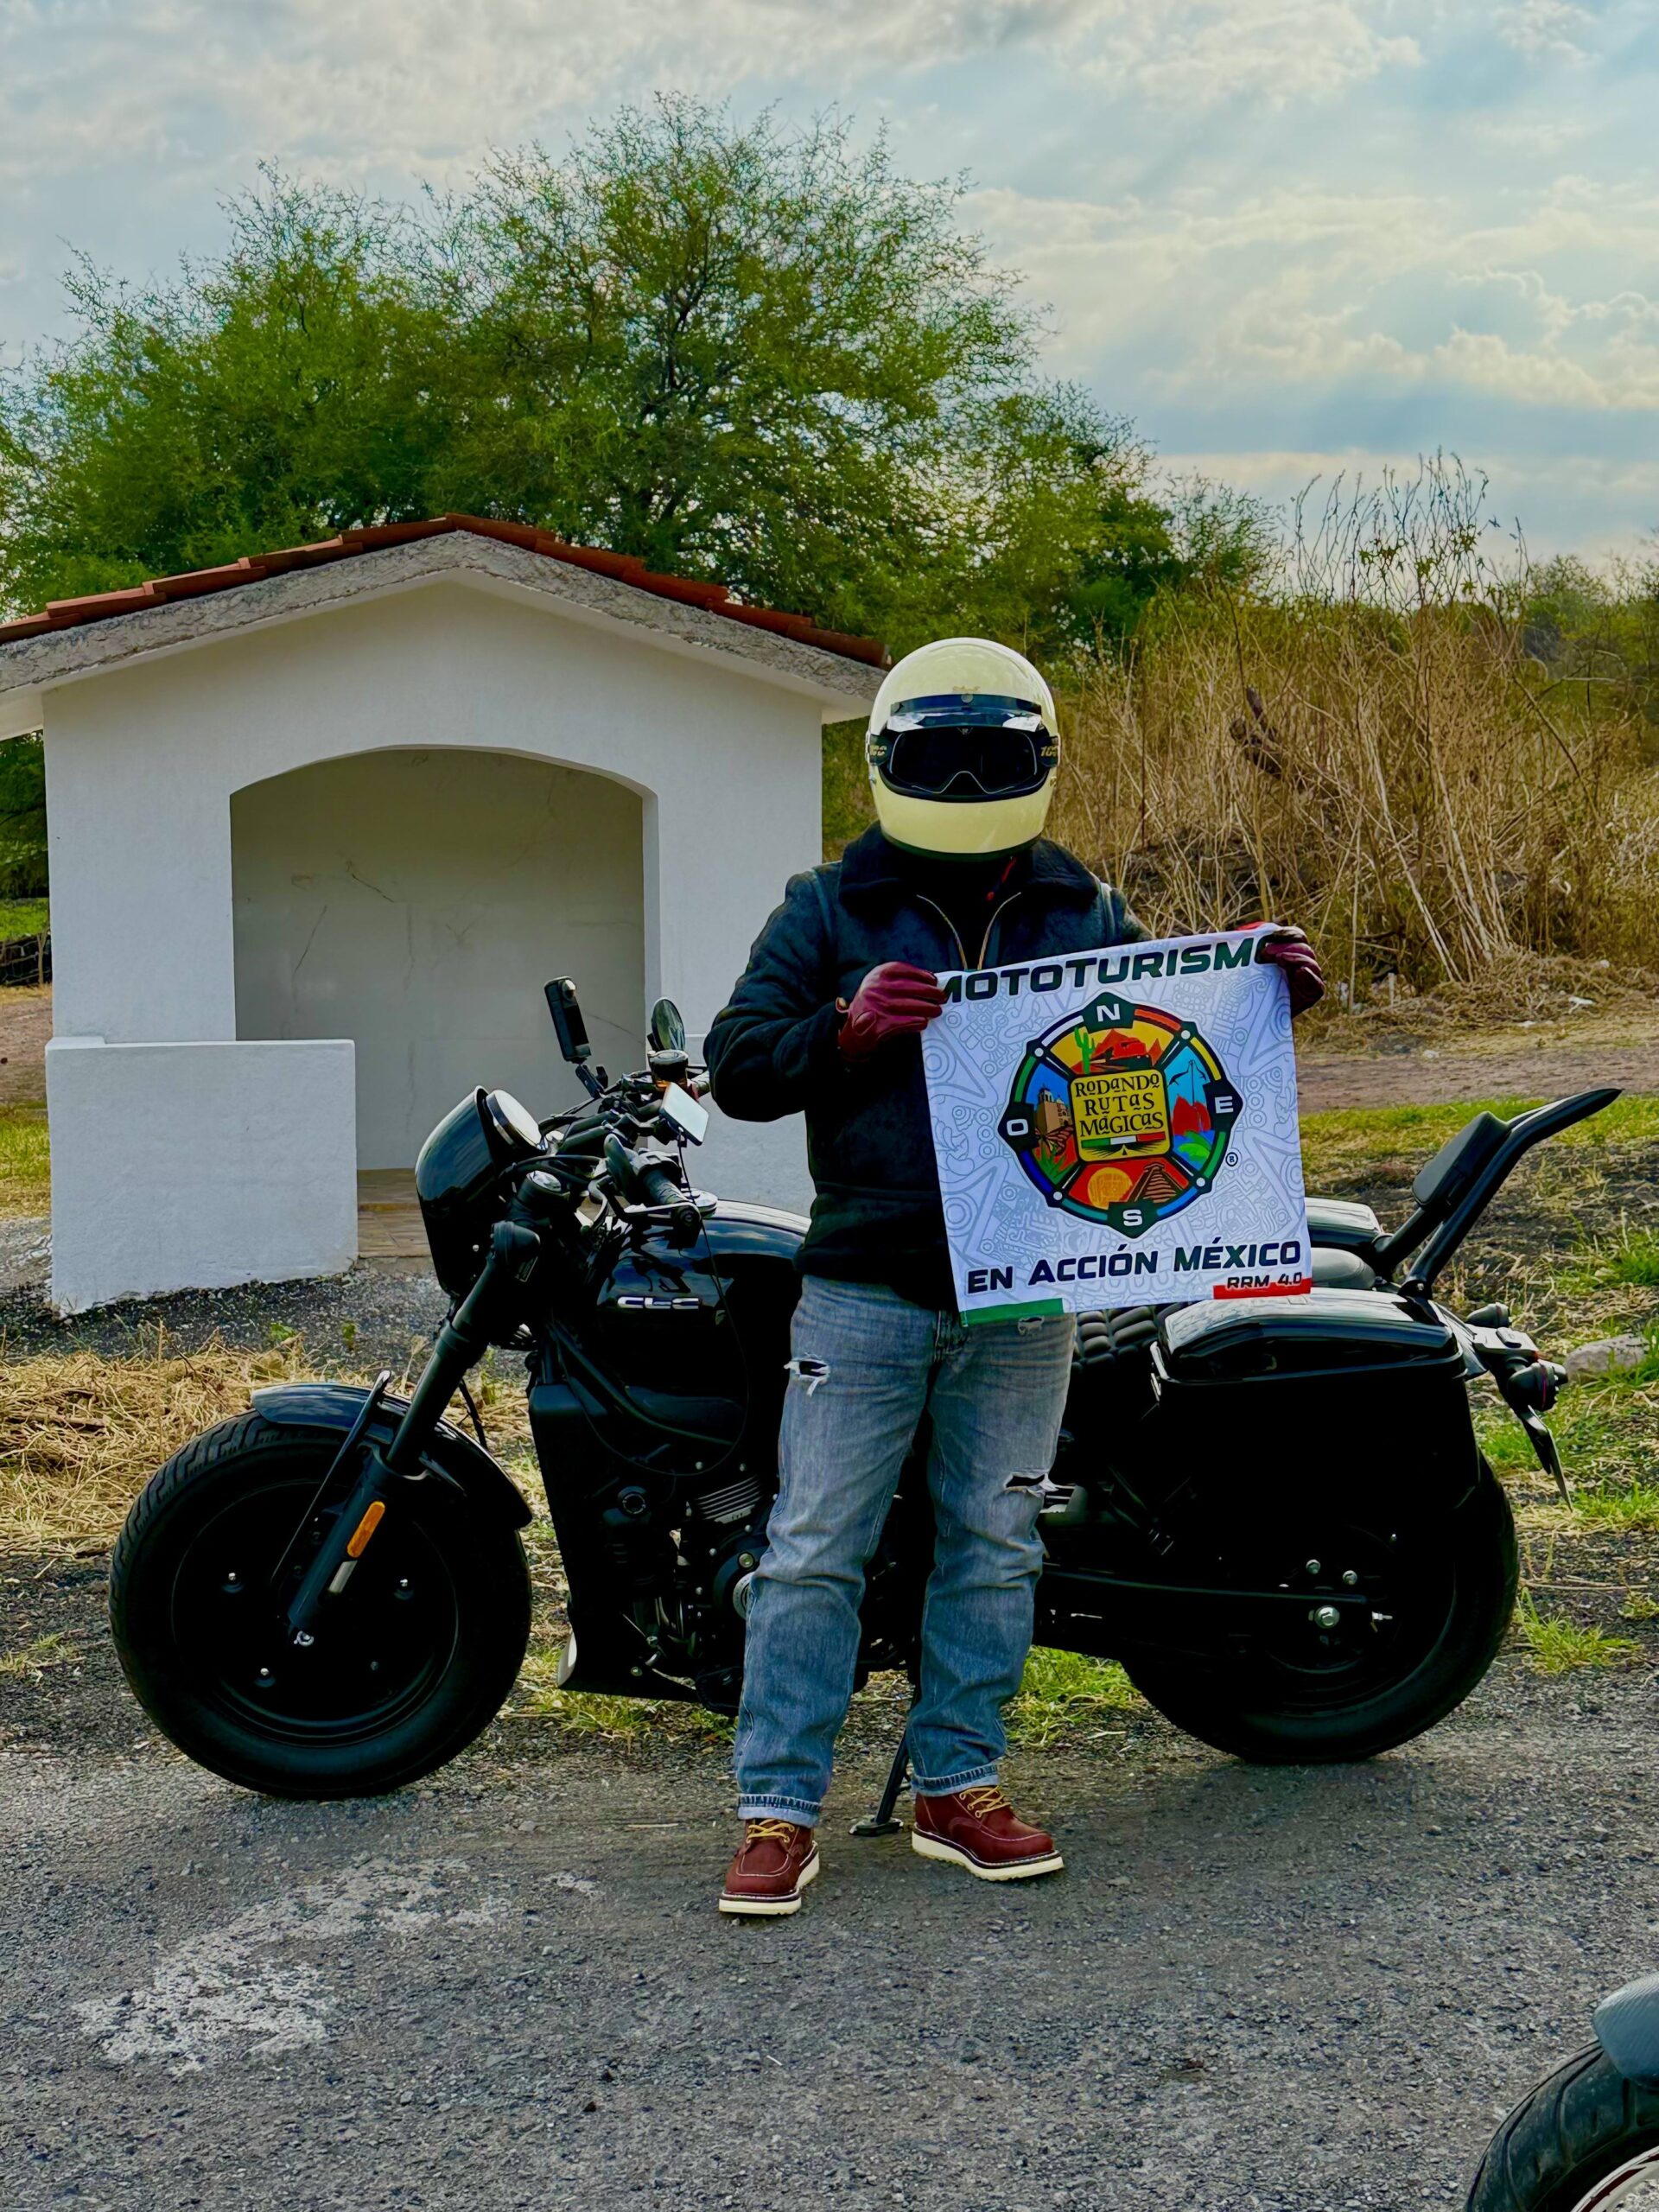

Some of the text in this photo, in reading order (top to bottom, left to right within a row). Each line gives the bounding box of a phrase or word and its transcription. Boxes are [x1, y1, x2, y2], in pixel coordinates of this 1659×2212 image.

[1096, 1003, 1121, 1022] N
[1214, 1096, 1234, 1114] E
[1006, 1118, 1028, 1136] O
[1122, 1209, 1143, 1226] S
[968, 1236, 1300, 1294] EN ACCIÓN MÉXICO
[1227, 1272, 1302, 1289] RRM 4.0
